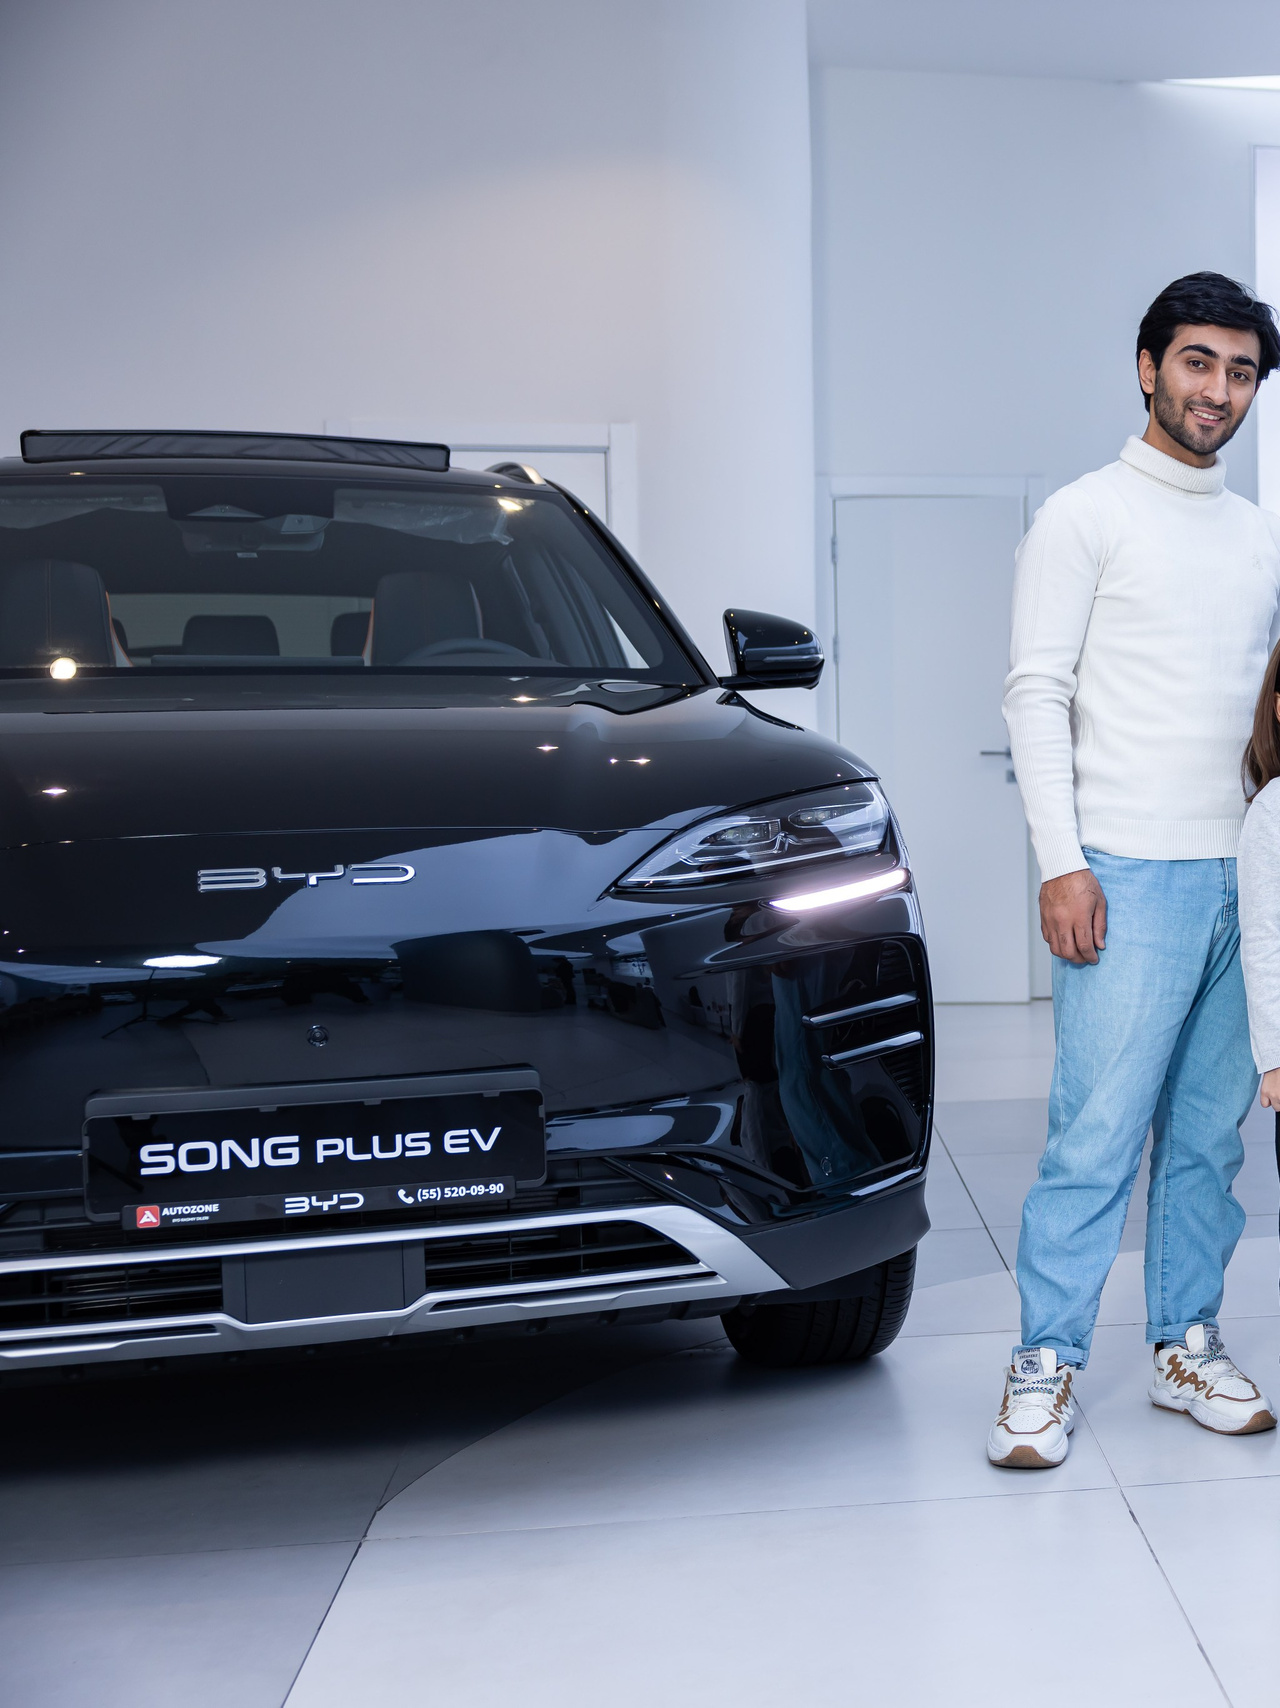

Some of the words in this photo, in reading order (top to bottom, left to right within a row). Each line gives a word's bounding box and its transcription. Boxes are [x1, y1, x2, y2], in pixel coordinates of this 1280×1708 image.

[197, 863, 417, 892] BYD
[139, 1135, 300, 1176] SONG
[316, 1131, 432, 1164] PLUS
[443, 1126, 502, 1155] EV
[284, 1192, 365, 1215] BYD
[416, 1187, 442, 1203] (55)
[444, 1182, 505, 1199] 520-09-90
[161, 1203, 220, 1216] AUTOZONE
